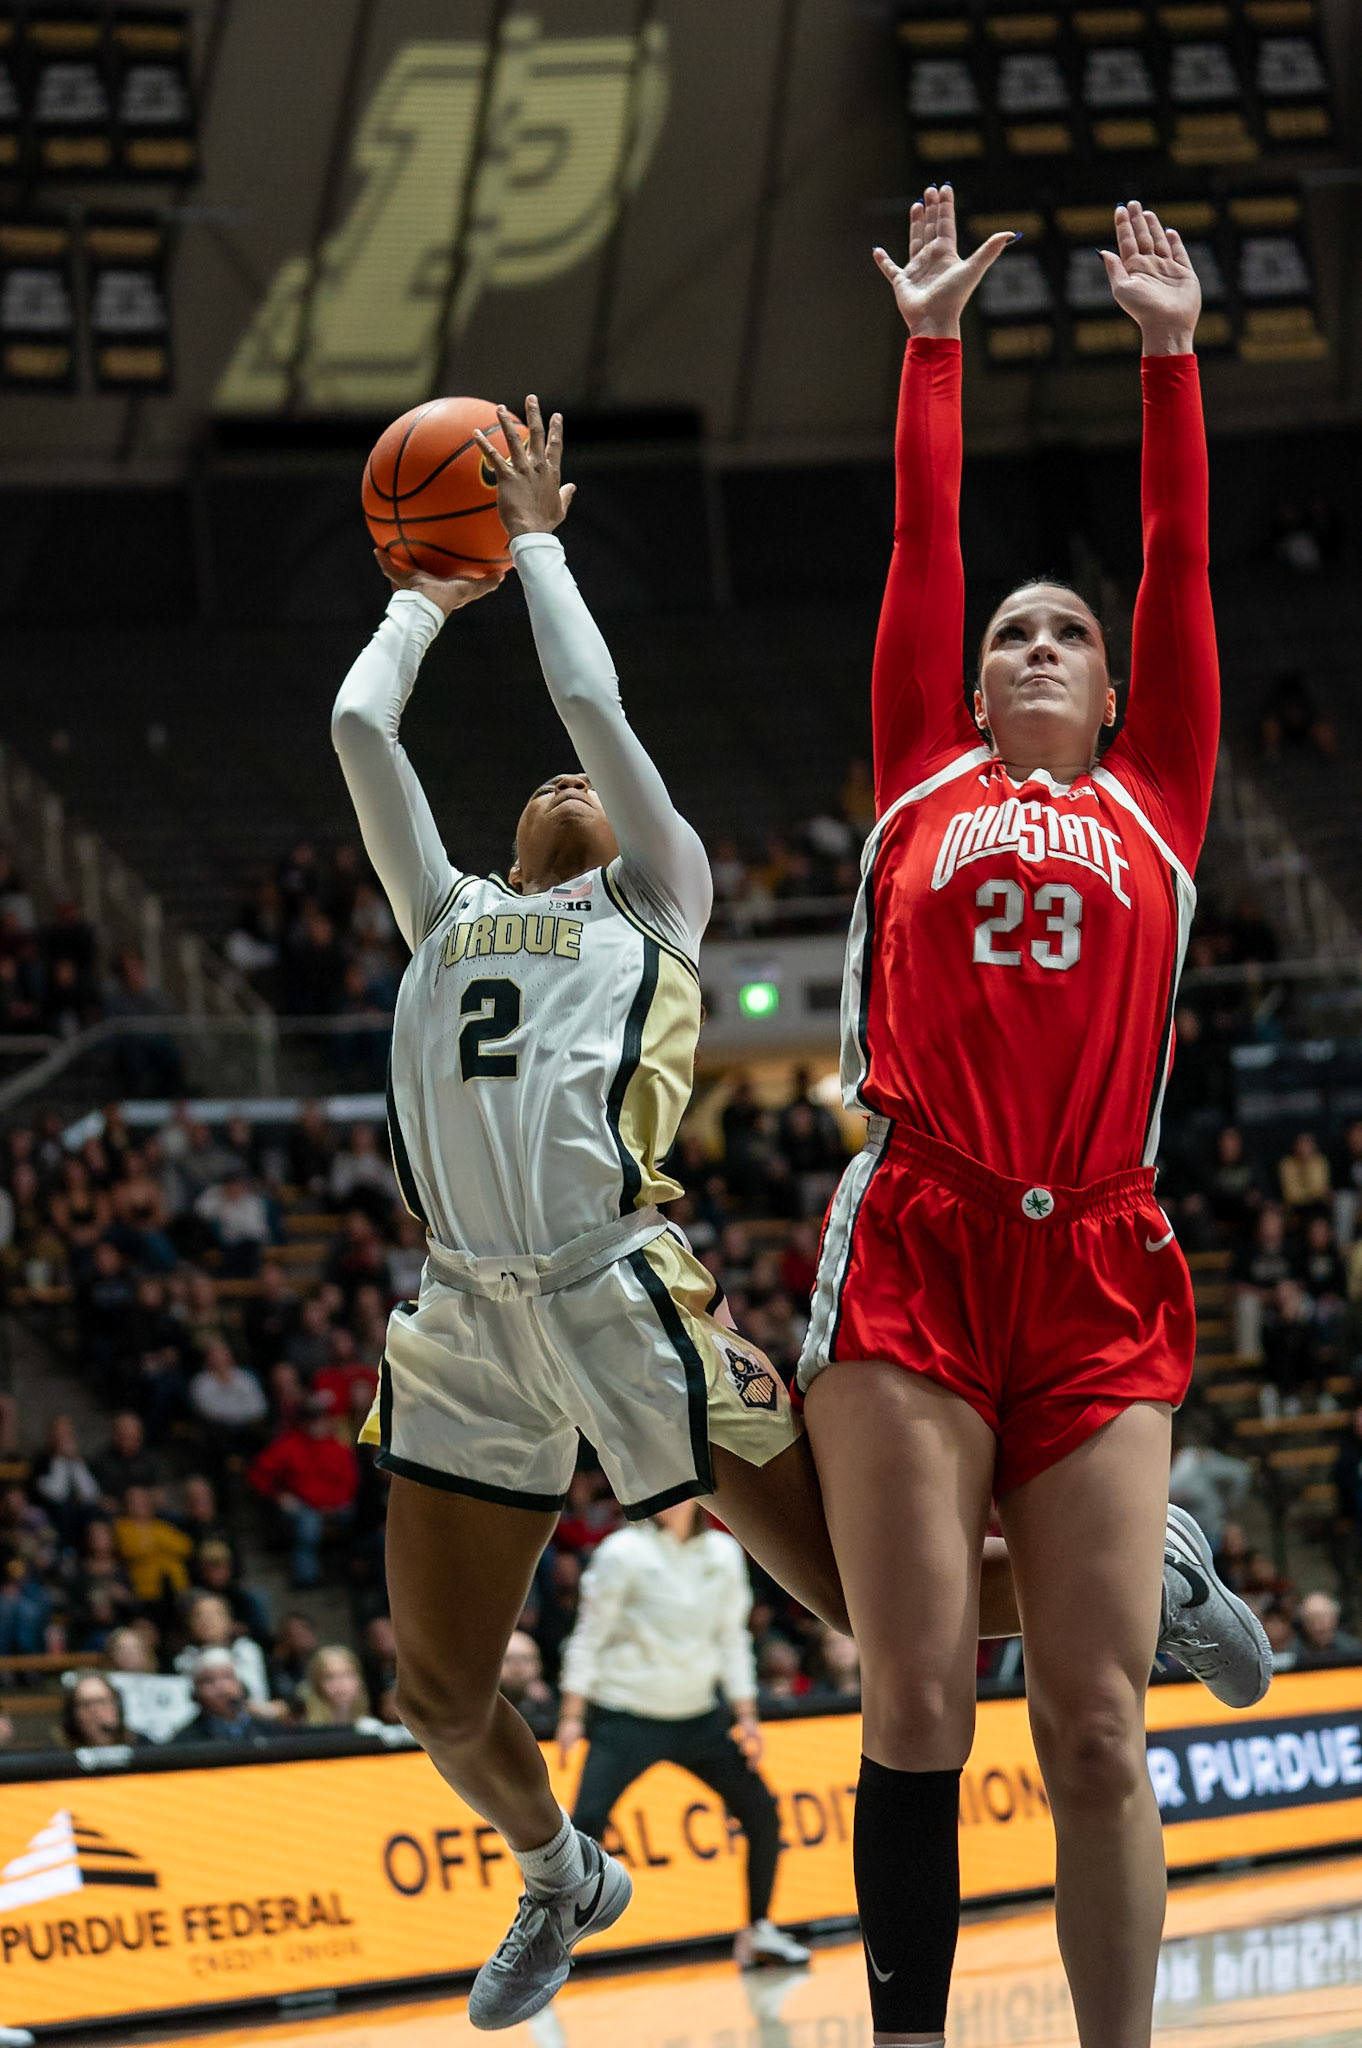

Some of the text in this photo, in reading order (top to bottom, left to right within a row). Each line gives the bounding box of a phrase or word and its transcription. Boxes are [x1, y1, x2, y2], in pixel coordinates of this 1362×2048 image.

[1017, 801, 1131, 910] STATE
[434, 914, 583, 988] URDUE
[972, 878, 1083, 970] 23
[458, 977, 522, 1083] 2
[1186, 1724, 1361, 1804] PURDUE
[384, 1810, 670, 1897] OFFAL
[958, 1766, 1050, 1824] ION
[2, 1893, 353, 1964] PURDUE FEDERAL
